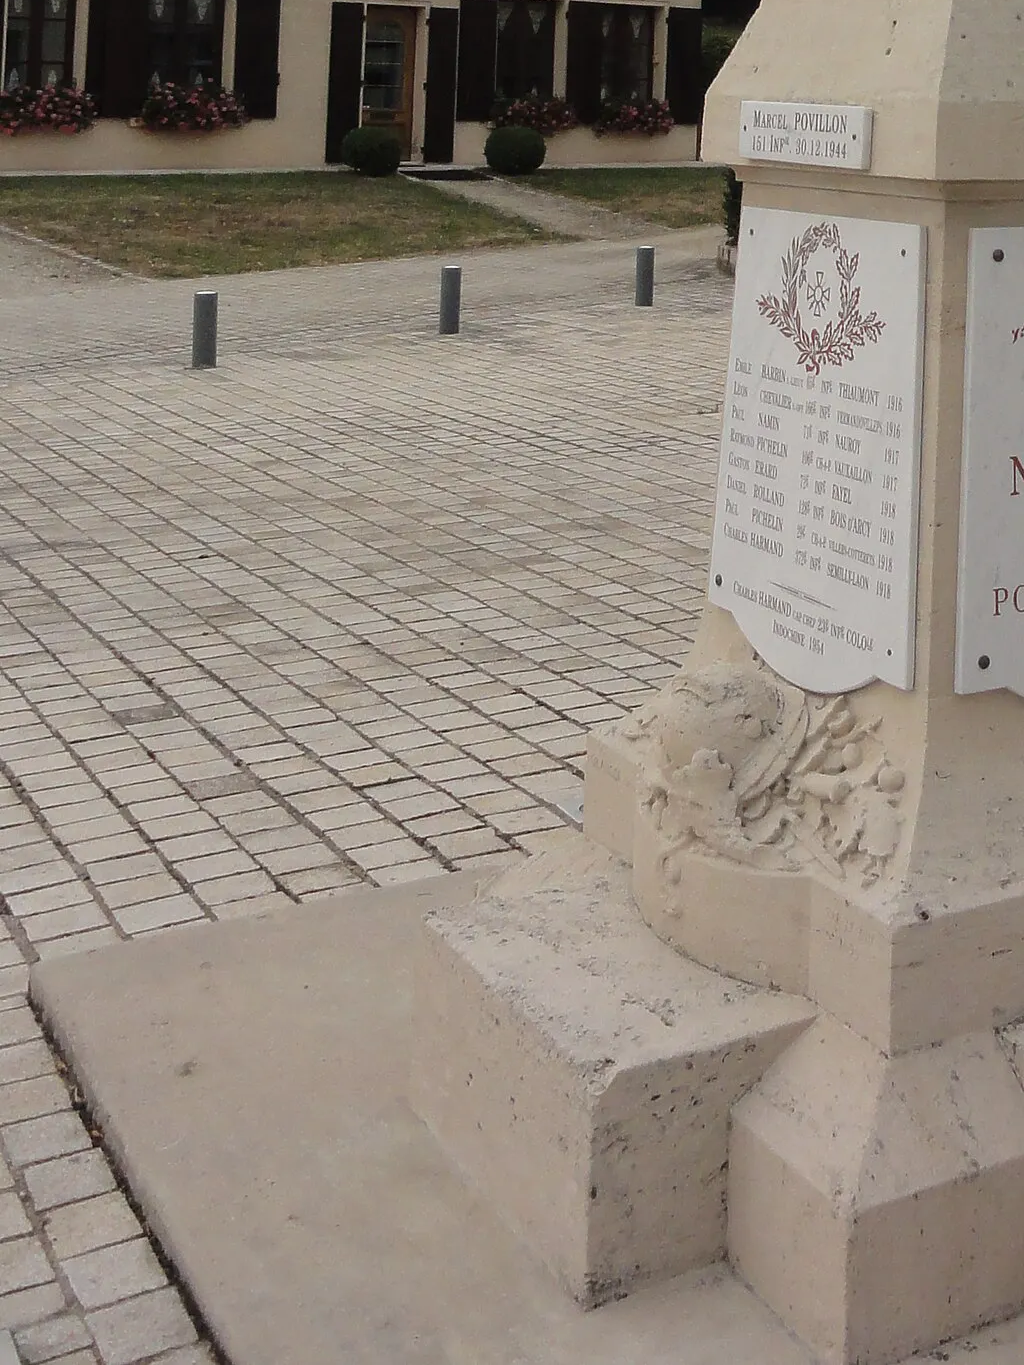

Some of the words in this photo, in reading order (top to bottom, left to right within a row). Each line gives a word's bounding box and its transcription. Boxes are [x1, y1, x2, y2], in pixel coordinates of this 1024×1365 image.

[753, 110, 788, 130] MARCEL
[794, 112, 848, 134] POVILLON
[752, 135, 767, 152] 151
[795, 138, 848, 159] 30.12.1944
[838, 382, 880, 407] THIAUMONT
[886, 394, 904, 412] 1916
[885, 421, 901, 439] 1916
[883, 447, 900, 466] 1917
[882, 474, 898, 492] 1917
[753, 483, 785, 507] ROLLAND
[830, 509, 847, 529] BOIS
[879, 527, 895, 546] 1918
[881, 500, 896, 519] 1918
[751, 507, 784, 533] PICHELIN
[878, 553, 893, 573] 1918
[723, 522, 748, 544] CHARLES
[750, 532, 784, 558] HARMAND
[876, 580, 891, 599] 1918
[732, 580, 758, 602] CHARLES
[758, 591, 792, 617] HARMAND
[772, 619, 806, 647] INDOCHINE
[808, 636, 826, 655] 1954
